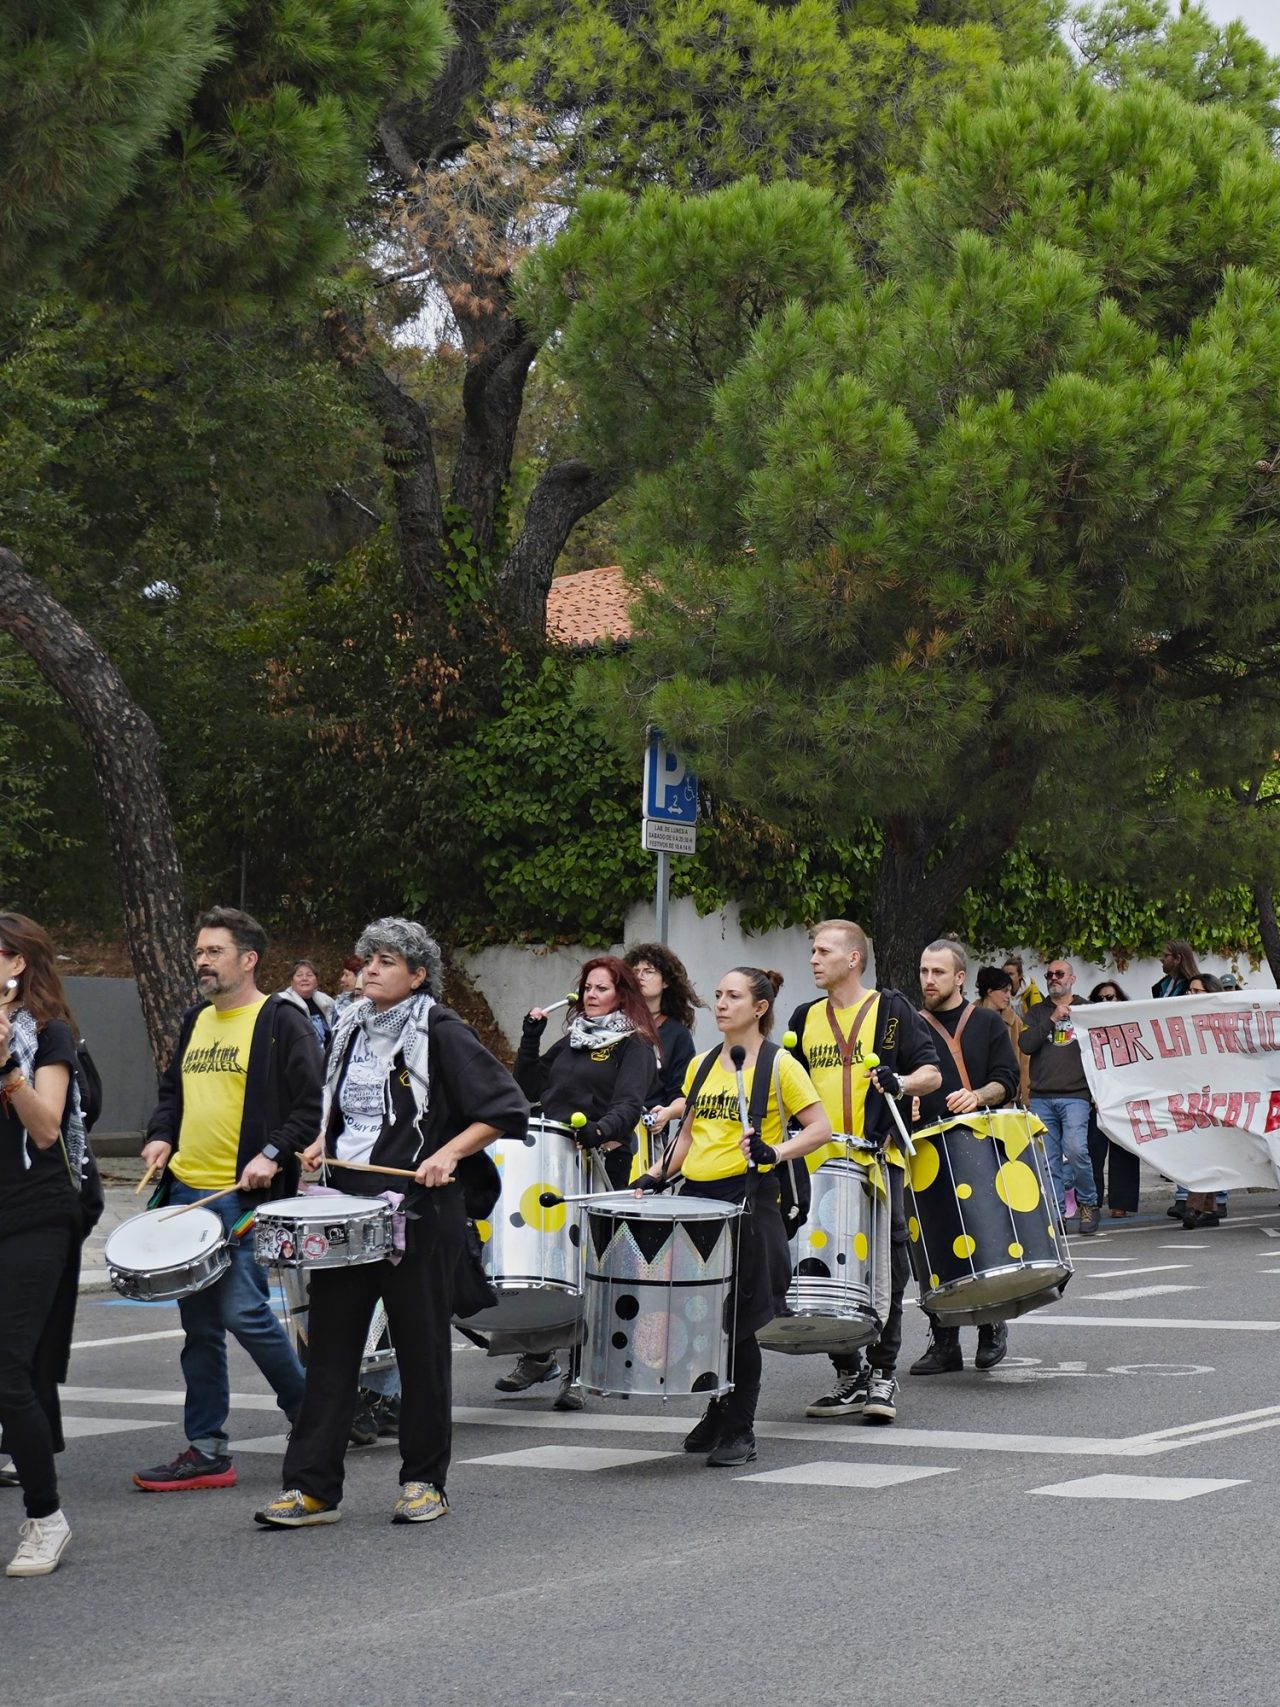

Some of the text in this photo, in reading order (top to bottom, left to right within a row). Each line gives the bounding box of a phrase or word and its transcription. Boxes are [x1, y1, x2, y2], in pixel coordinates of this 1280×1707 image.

[655, 738, 686, 809] P
[1088, 1022, 1153, 1070] POR
[1150, 1016, 1192, 1058] LA
[1126, 1099, 1168, 1145] EL
